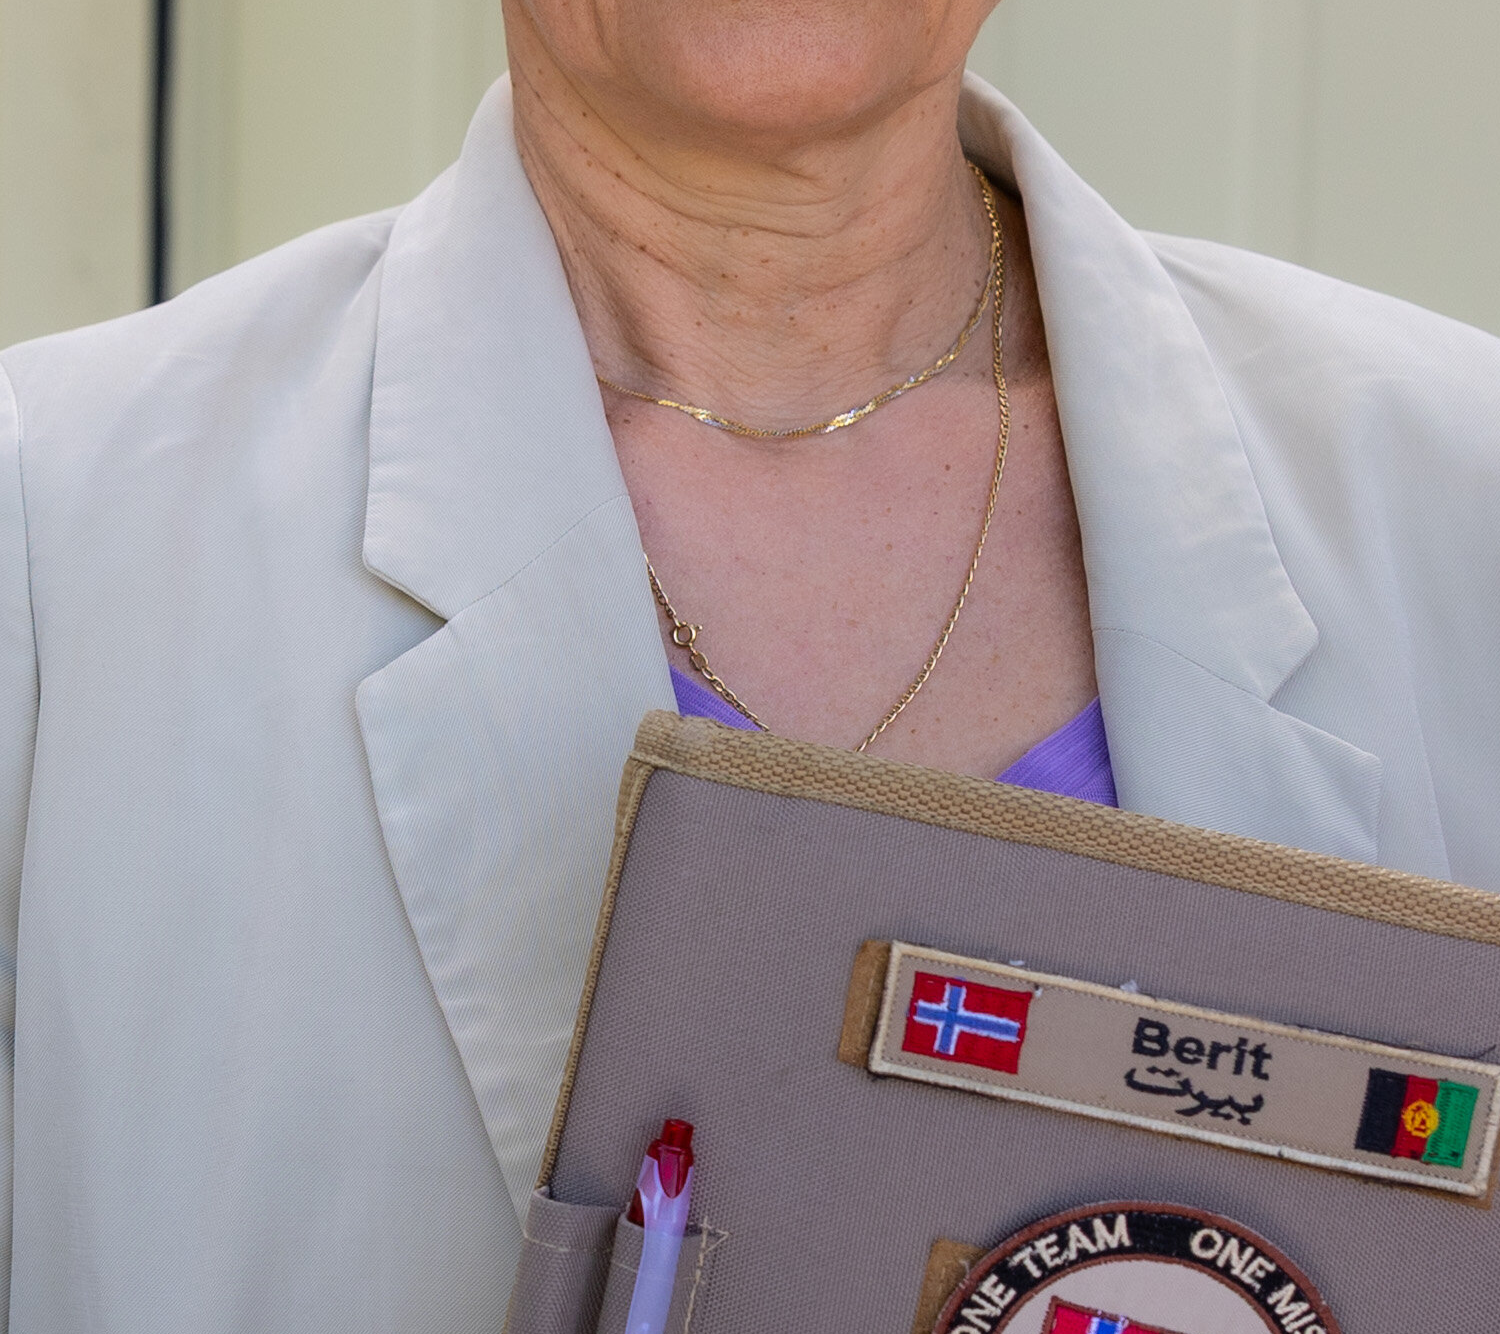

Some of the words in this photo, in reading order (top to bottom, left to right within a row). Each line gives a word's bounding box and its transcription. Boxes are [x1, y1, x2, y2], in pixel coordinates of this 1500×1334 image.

[1132, 1017, 1272, 1080] Berit
[1013, 1214, 1131, 1278] TEAM
[1190, 1228, 1276, 1293] ONE
